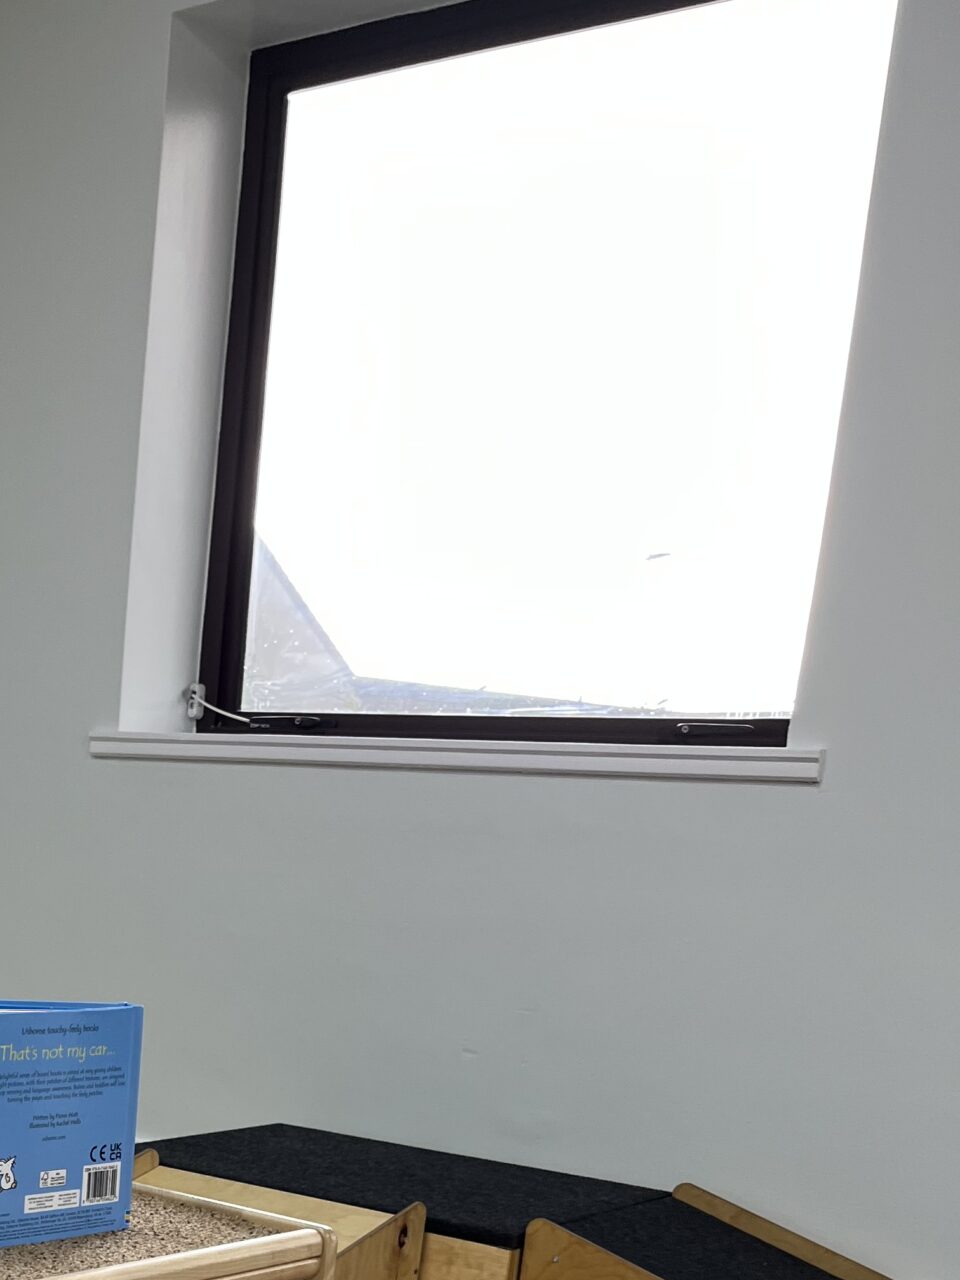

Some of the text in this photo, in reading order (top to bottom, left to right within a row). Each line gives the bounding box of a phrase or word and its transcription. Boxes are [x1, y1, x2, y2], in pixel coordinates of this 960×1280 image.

[0, 1043, 38, 1062] That's
[41, 1044, 64, 1061] not
[67, 1046, 87, 1063] my
